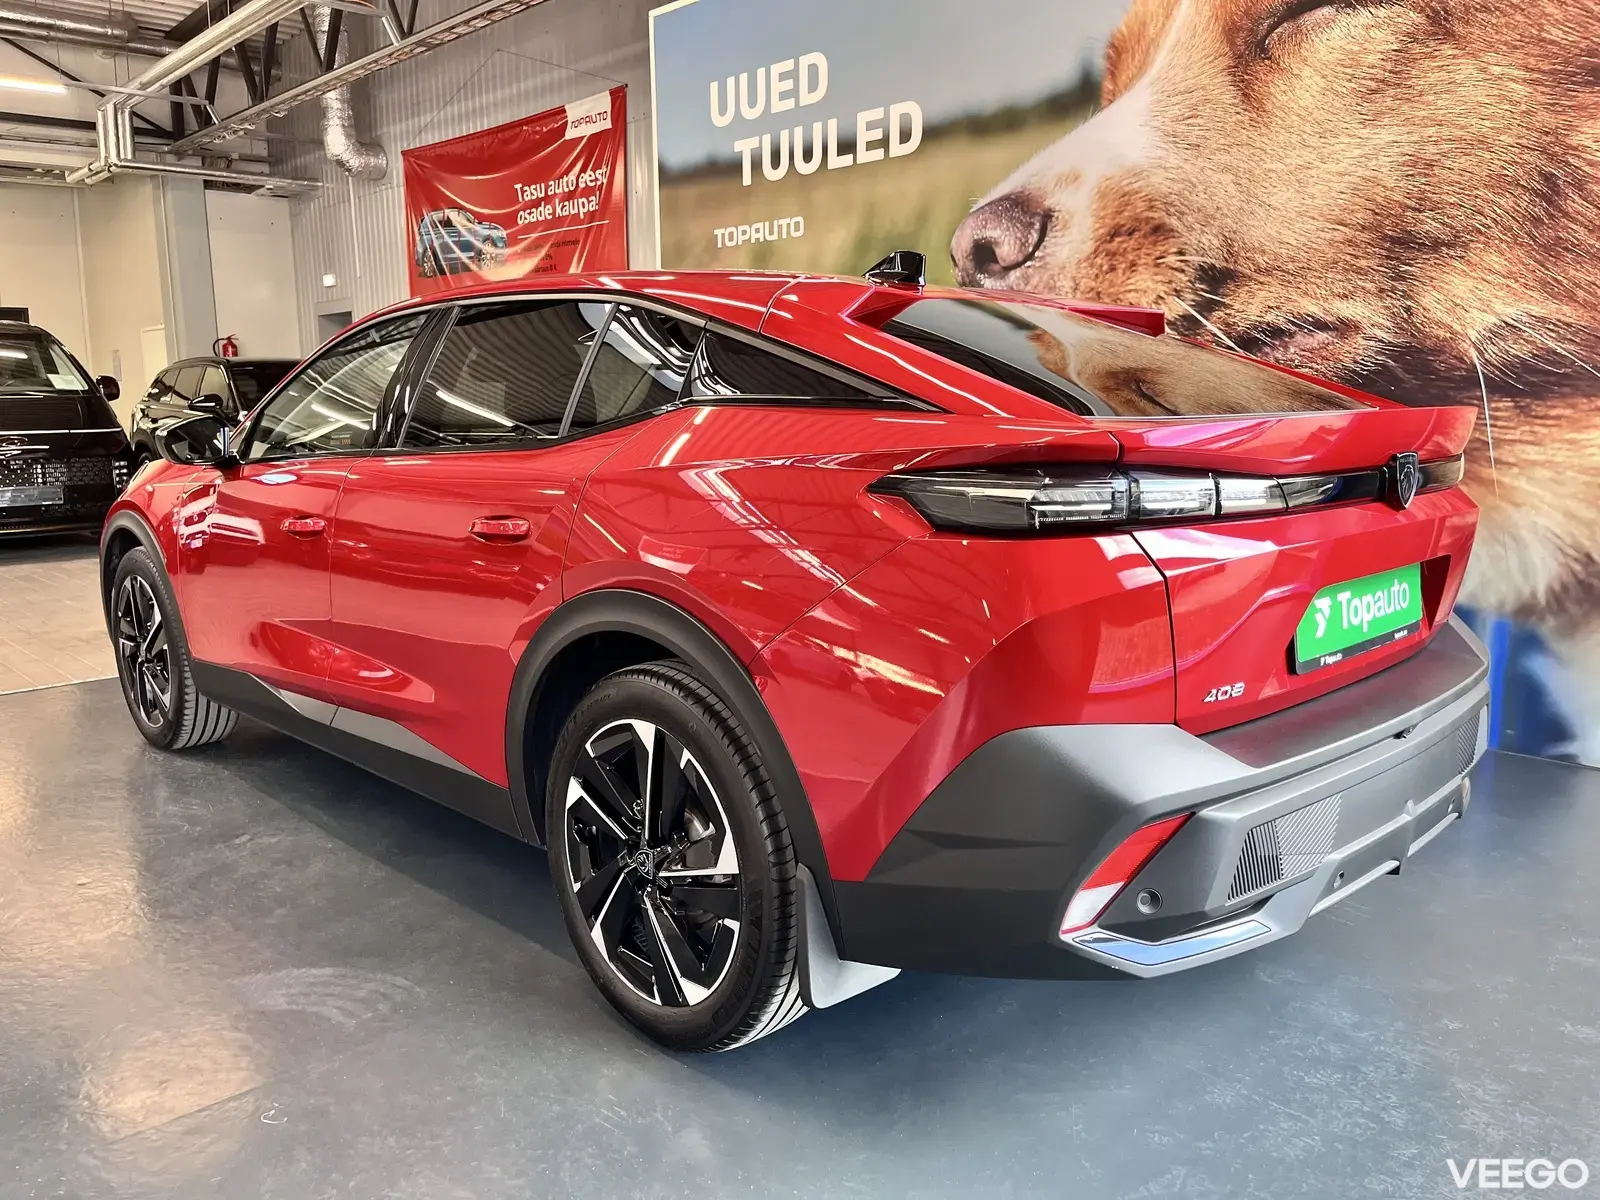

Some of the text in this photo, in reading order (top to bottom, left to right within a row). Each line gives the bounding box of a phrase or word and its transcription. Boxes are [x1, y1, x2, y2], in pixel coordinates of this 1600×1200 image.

[710, 52, 829, 128] UUED
[570, 110, 608, 130] TOPAUTO
[733, 100, 923, 187] TUULED
[514, 167, 608, 202] Tasu auto eest
[517, 191, 600, 225] osade kaupa!
[713, 216, 805, 249] TOPAUTO
[1337, 579, 1410, 633] Topauto
[1203, 682, 1246, 703] 408
